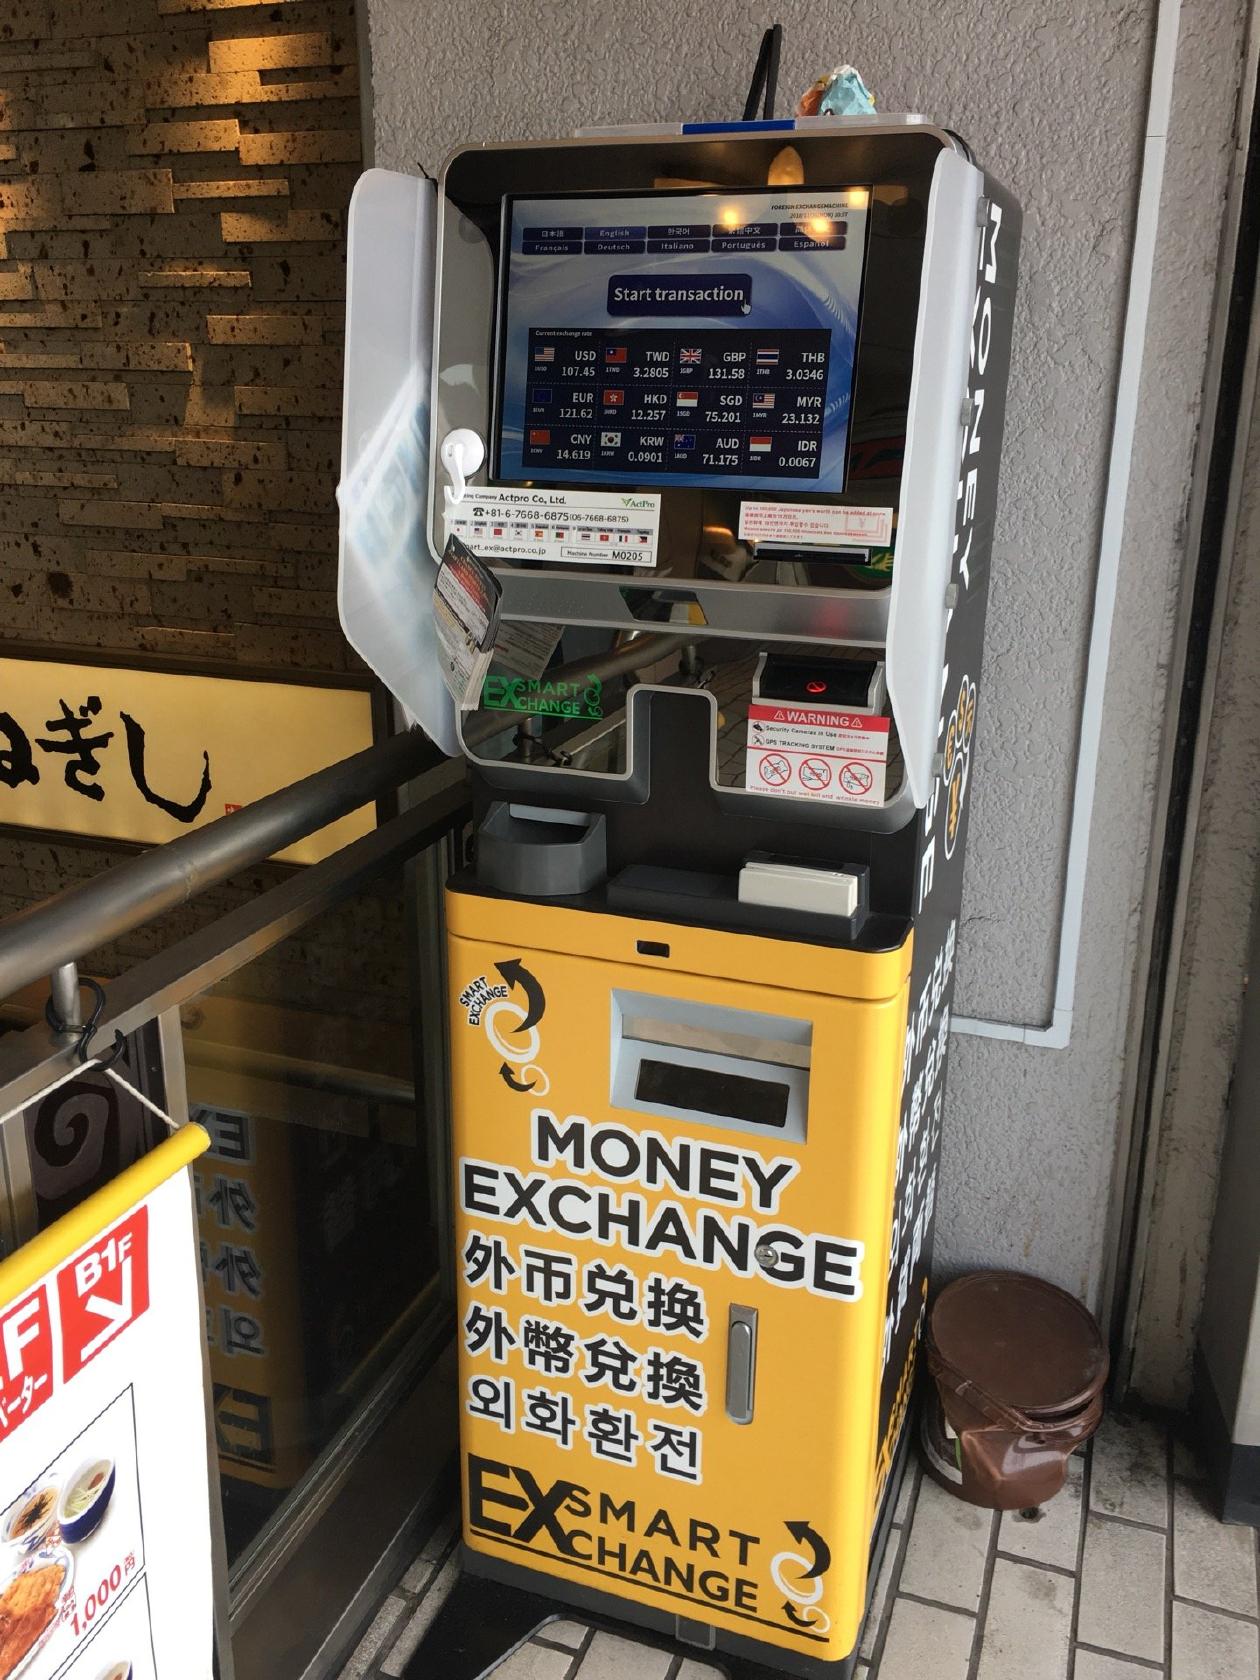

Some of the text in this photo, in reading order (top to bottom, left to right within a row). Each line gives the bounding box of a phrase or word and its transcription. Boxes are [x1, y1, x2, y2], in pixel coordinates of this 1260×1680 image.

[599, 229, 630, 239] English
[535, 244, 568, 253] Français
[597, 243, 630, 251] Deutsch
[661, 242, 694, 250] Italiano
[722, 240, 766, 250] Português
[613, 284, 745, 302] Start transaction
[574, 350, 597, 361] USD
[645, 351, 670, 362] TWD
[723, 352, 747, 362] GBP
[801, 352, 825, 363] THB
[561, 366, 596, 377] 107.45
[633, 367, 669, 378] 3.2805
[708, 368, 745, 379] 131.58
[785, 369, 824, 380] 3.0346
[572, 392, 594, 403] EUR
[644, 394, 667, 404] HKD
[719, 395, 743, 406] SGD
[796, 396, 822, 407] MYR
[959, 202, 1003, 591] MONEY
[559, 408, 593, 419] 121.62
[631, 409, 666, 420] 12.257
[705, 411, 741, 423] 75.201
[781, 413, 820, 424] 23.132
[570, 434, 592, 444] CNY
[640, 436, 665, 446] KRW
[715, 438, 740, 449] AUD
[797, 440, 817, 451] IDR
[556, 449, 591, 459] 14.619
[627, 451, 663, 462] 0.0901
[702, 454, 738, 465] 71.175
[778, 457, 816, 468] 0.0067
[499, 493, 530, 504] Actpro
[549, 495, 567, 505] Ltd.
[485, 508, 569, 521] +81-6-7668-6875
[612, 550, 643, 561] M0205
[517, 678, 581, 697] SMART
[787, 710, 850, 727] WARNING
[765, 725, 790, 733] Security
[779, 740, 810, 749] TRACKING
[810, 742, 836, 751] SYSTEM
[459, 976, 488, 1007] SMART
[468, 985, 508, 1026] EXCHANGE
[537, 1114, 793, 1209] MONEY
[463, 1163, 858, 1296] EXCHANGE
[74, 1232, 133, 1298] B1F
[464, 1234, 705, 1339] 外币兑换
[465, 1305, 706, 1411] 外幣兌換
[470, 1378, 699, 1480] 외화환전
[565, 1479, 760, 1567] SMART
